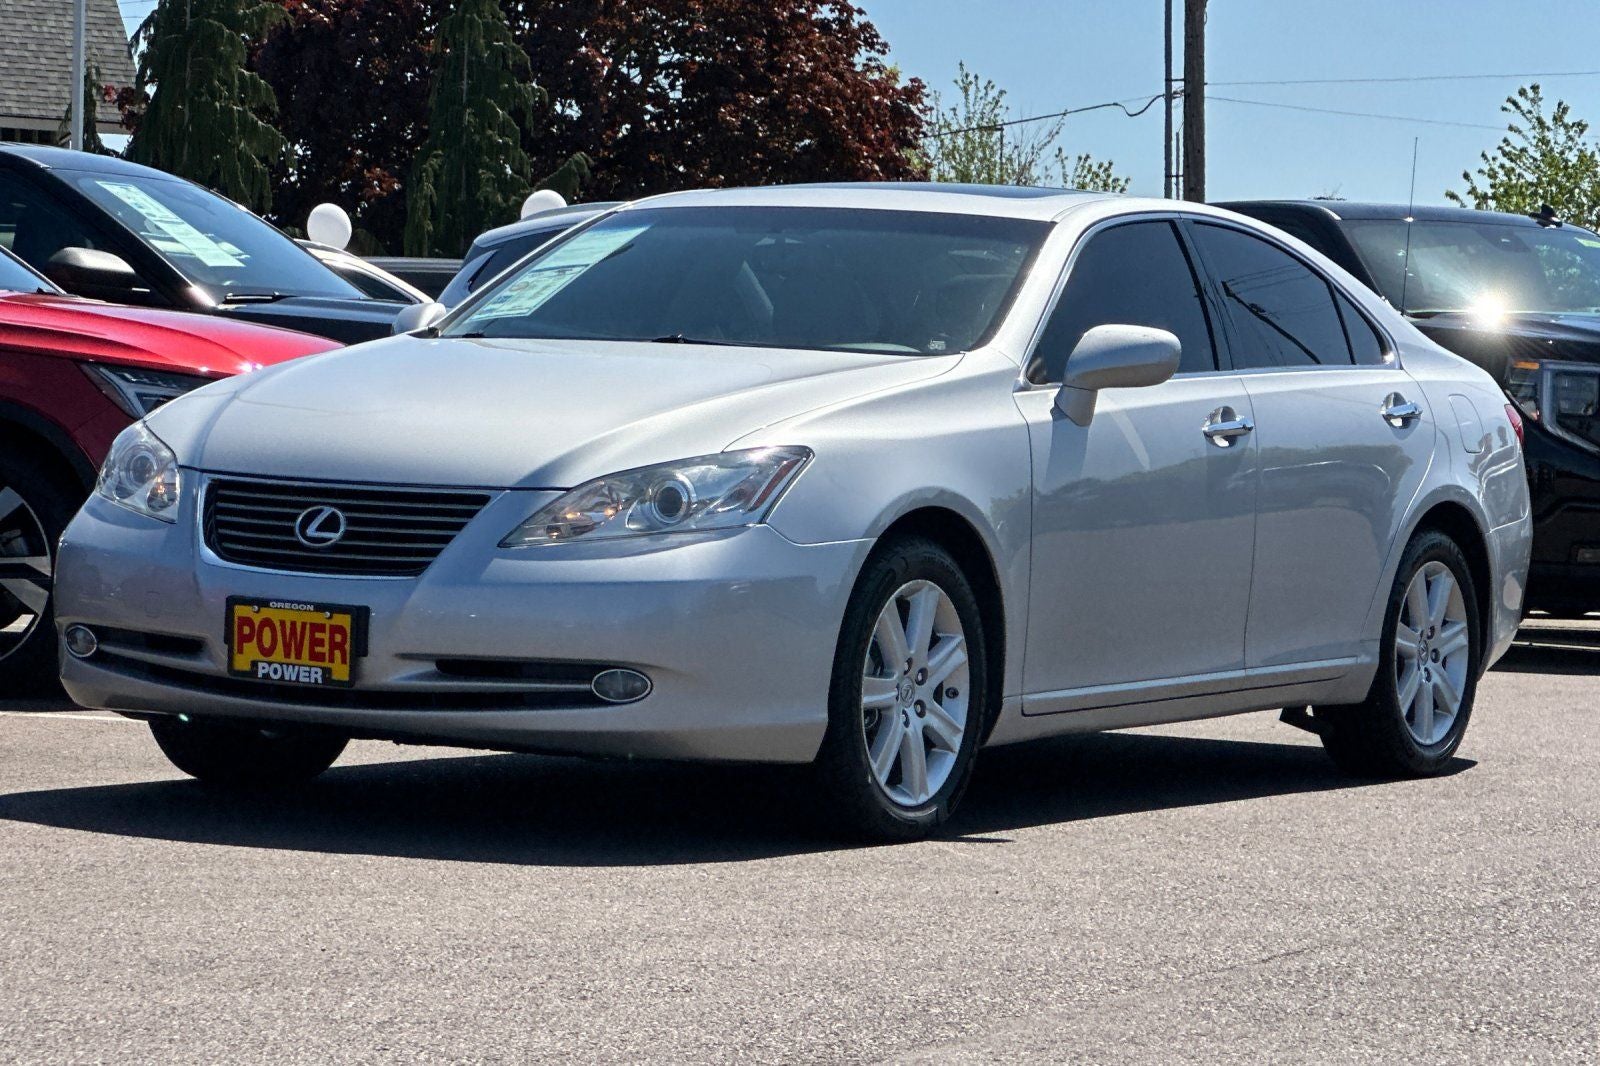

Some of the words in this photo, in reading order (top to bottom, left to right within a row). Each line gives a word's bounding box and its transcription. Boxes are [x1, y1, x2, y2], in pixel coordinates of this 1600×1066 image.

[269, 601, 314, 611] OREGON
[236, 616, 348, 665] POWER
[257, 662, 323, 684] POWER
